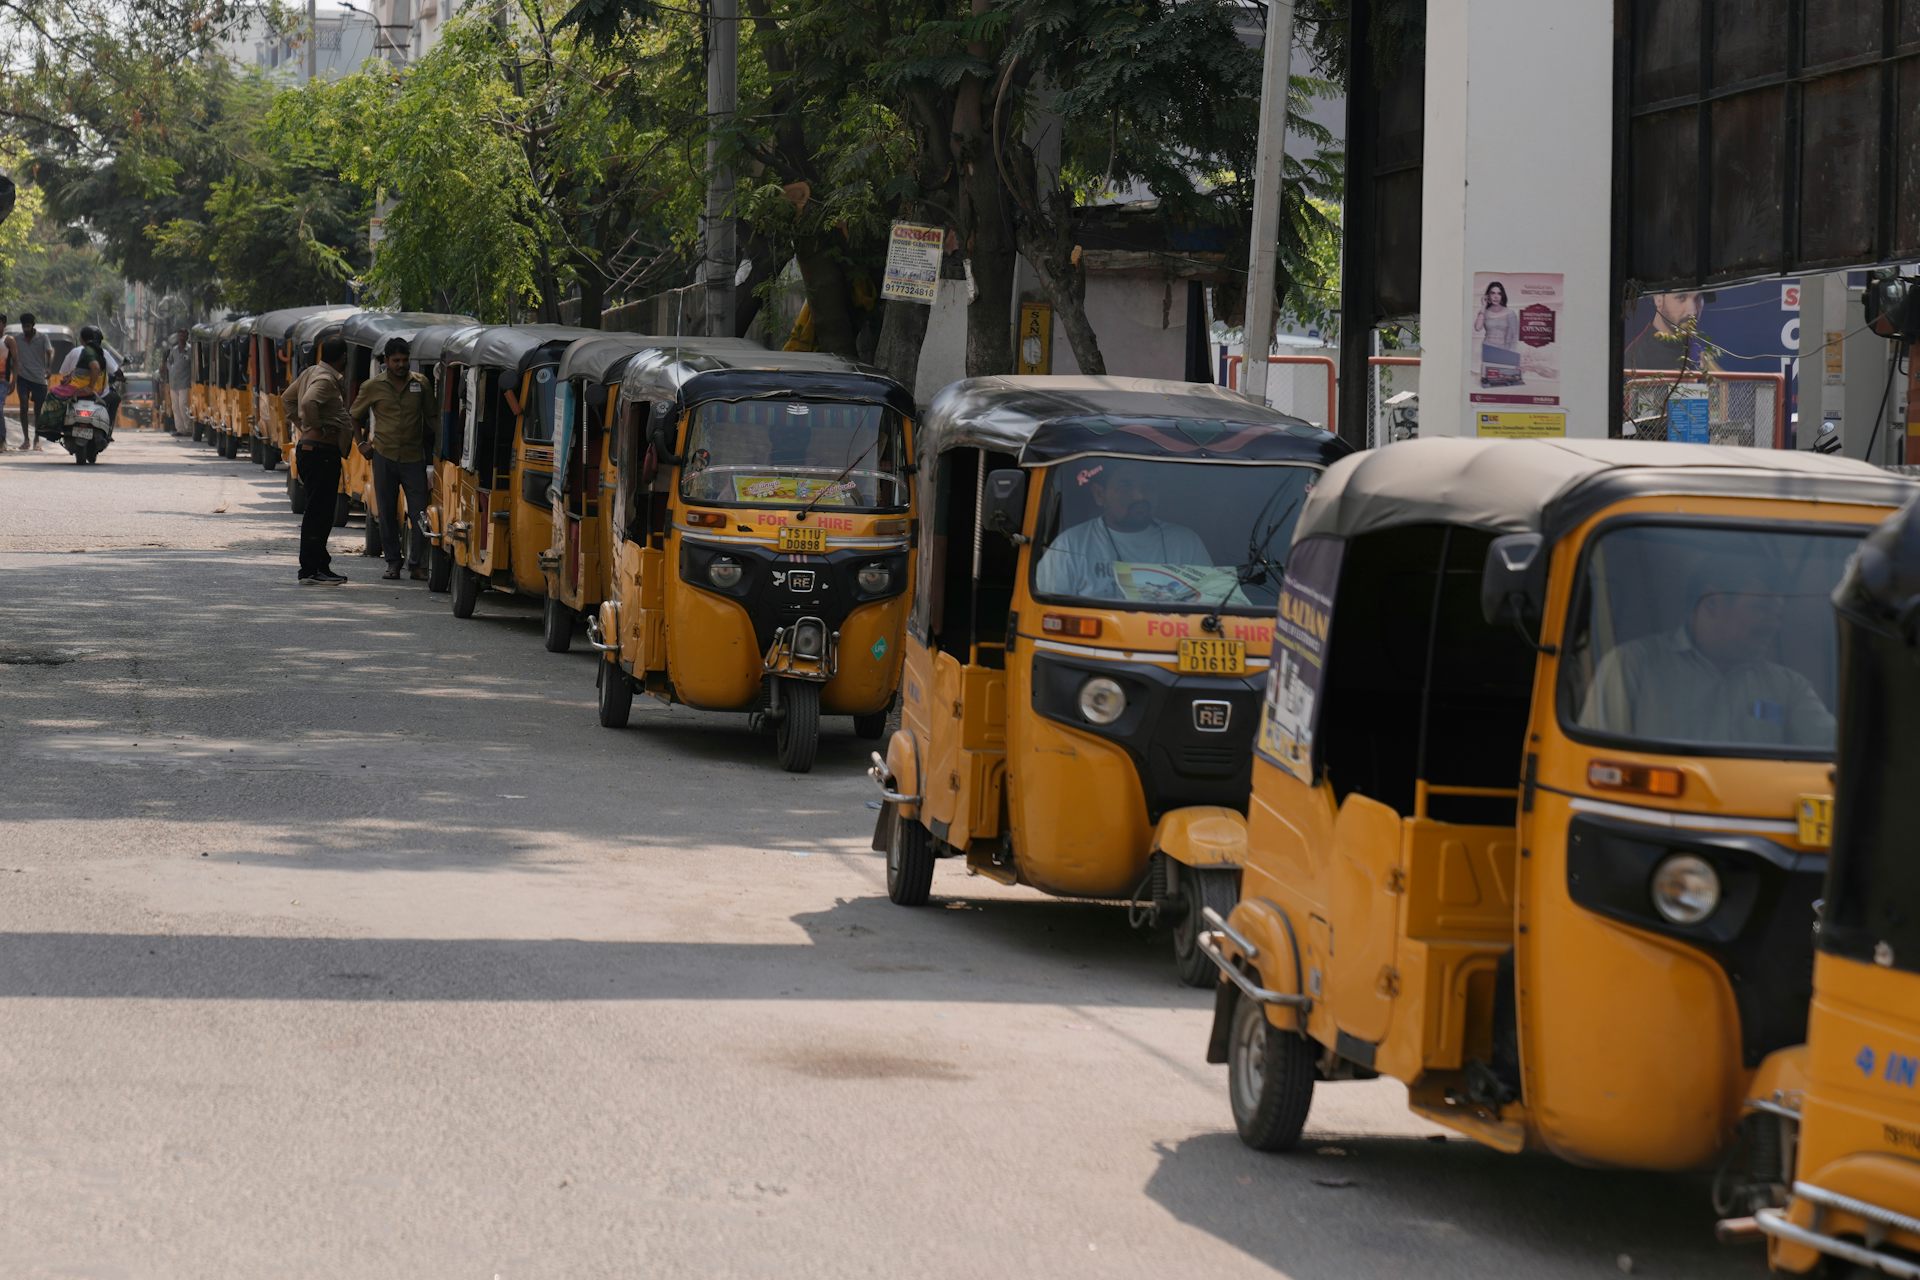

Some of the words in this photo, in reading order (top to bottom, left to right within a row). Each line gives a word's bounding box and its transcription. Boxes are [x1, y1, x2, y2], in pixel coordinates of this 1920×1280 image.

[885, 283, 934, 297] 9177324818
[758, 514, 788, 526] FOR
[817, 516, 853, 531] HIRE
[787, 528, 821, 540] TS11U
[792, 577, 811, 588] RE
[1148, 620, 1189, 638] FOR
[1235, 624, 1275, 643] HIR
[1190, 641, 1237, 656] TS11U
[1190, 656, 1237, 671] D1613
[1200, 710, 1224, 726] RE
